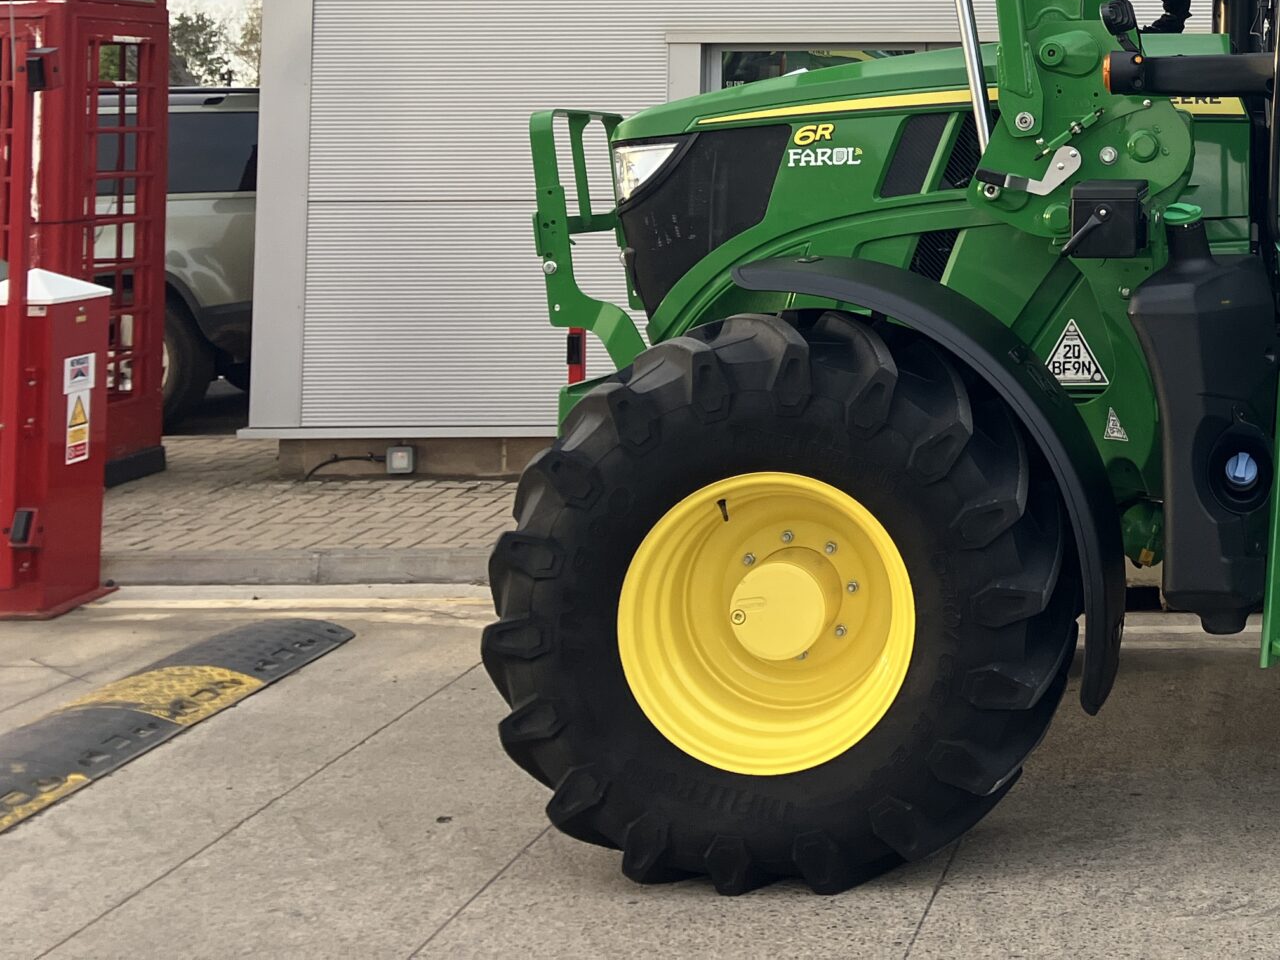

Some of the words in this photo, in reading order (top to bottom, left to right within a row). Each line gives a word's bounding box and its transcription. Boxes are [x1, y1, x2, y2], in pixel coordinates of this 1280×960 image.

[793, 123, 835, 146] 6R
[788, 147, 862, 167] FAROL
[1052, 360, 1092, 376] BF9N
